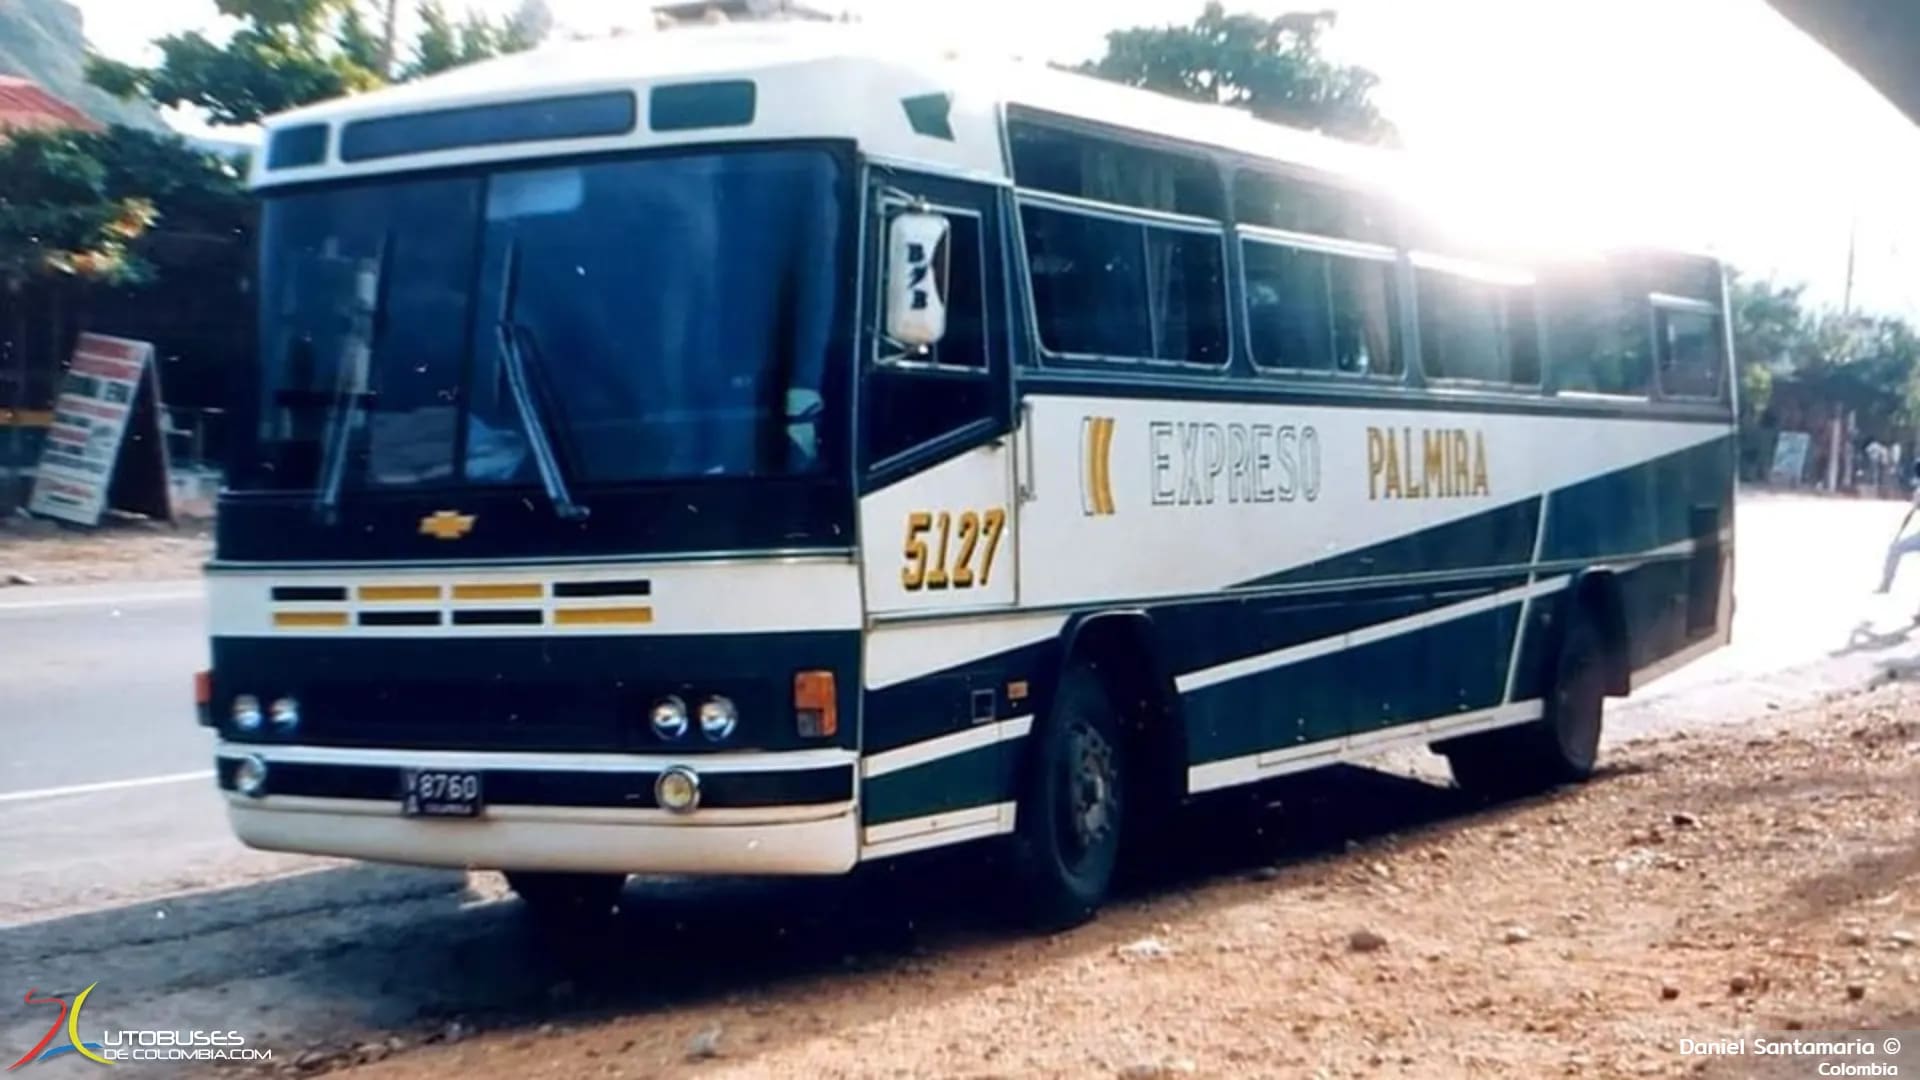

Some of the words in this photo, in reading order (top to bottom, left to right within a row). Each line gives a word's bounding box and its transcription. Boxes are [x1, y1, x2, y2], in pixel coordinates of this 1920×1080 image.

[1150, 421, 1322, 506] EXPRESO
[1367, 426, 1489, 500] PALMIRA
[902, 508, 1005, 591] 5127
[420, 774, 477, 799] 8760
